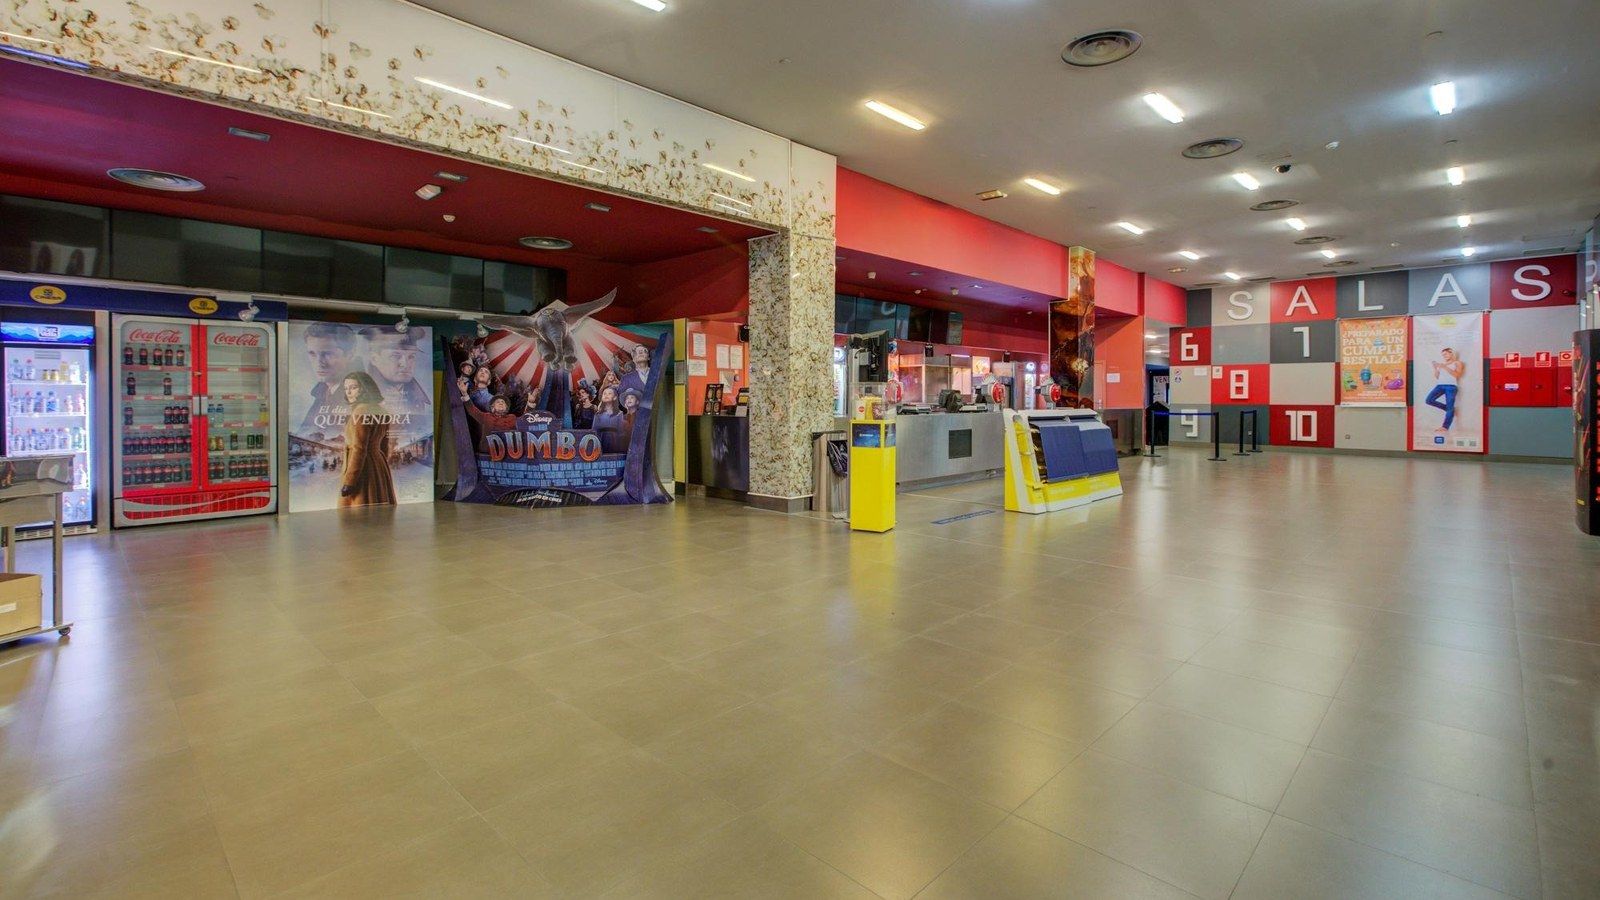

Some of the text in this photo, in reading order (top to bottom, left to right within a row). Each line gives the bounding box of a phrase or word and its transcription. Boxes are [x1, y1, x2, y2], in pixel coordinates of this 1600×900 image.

[1227, 264, 1552, 320] SALAS
[1181, 333, 1199, 361] 6
[1343, 335, 1404, 346] PARA UN
[1343, 344, 1404, 356] CUMPLE
[1343, 355, 1405, 365] BESTIAL?
[1230, 369, 1249, 400] 8
[314, 411, 412, 429] QUE VENDRÁ
[319, 405, 329, 414] El
[524, 412, 553, 426] Disney
[1181, 409, 1199, 437] 9
[1285, 410, 1318, 442] 10
[486, 430, 603, 462] DUMBO
